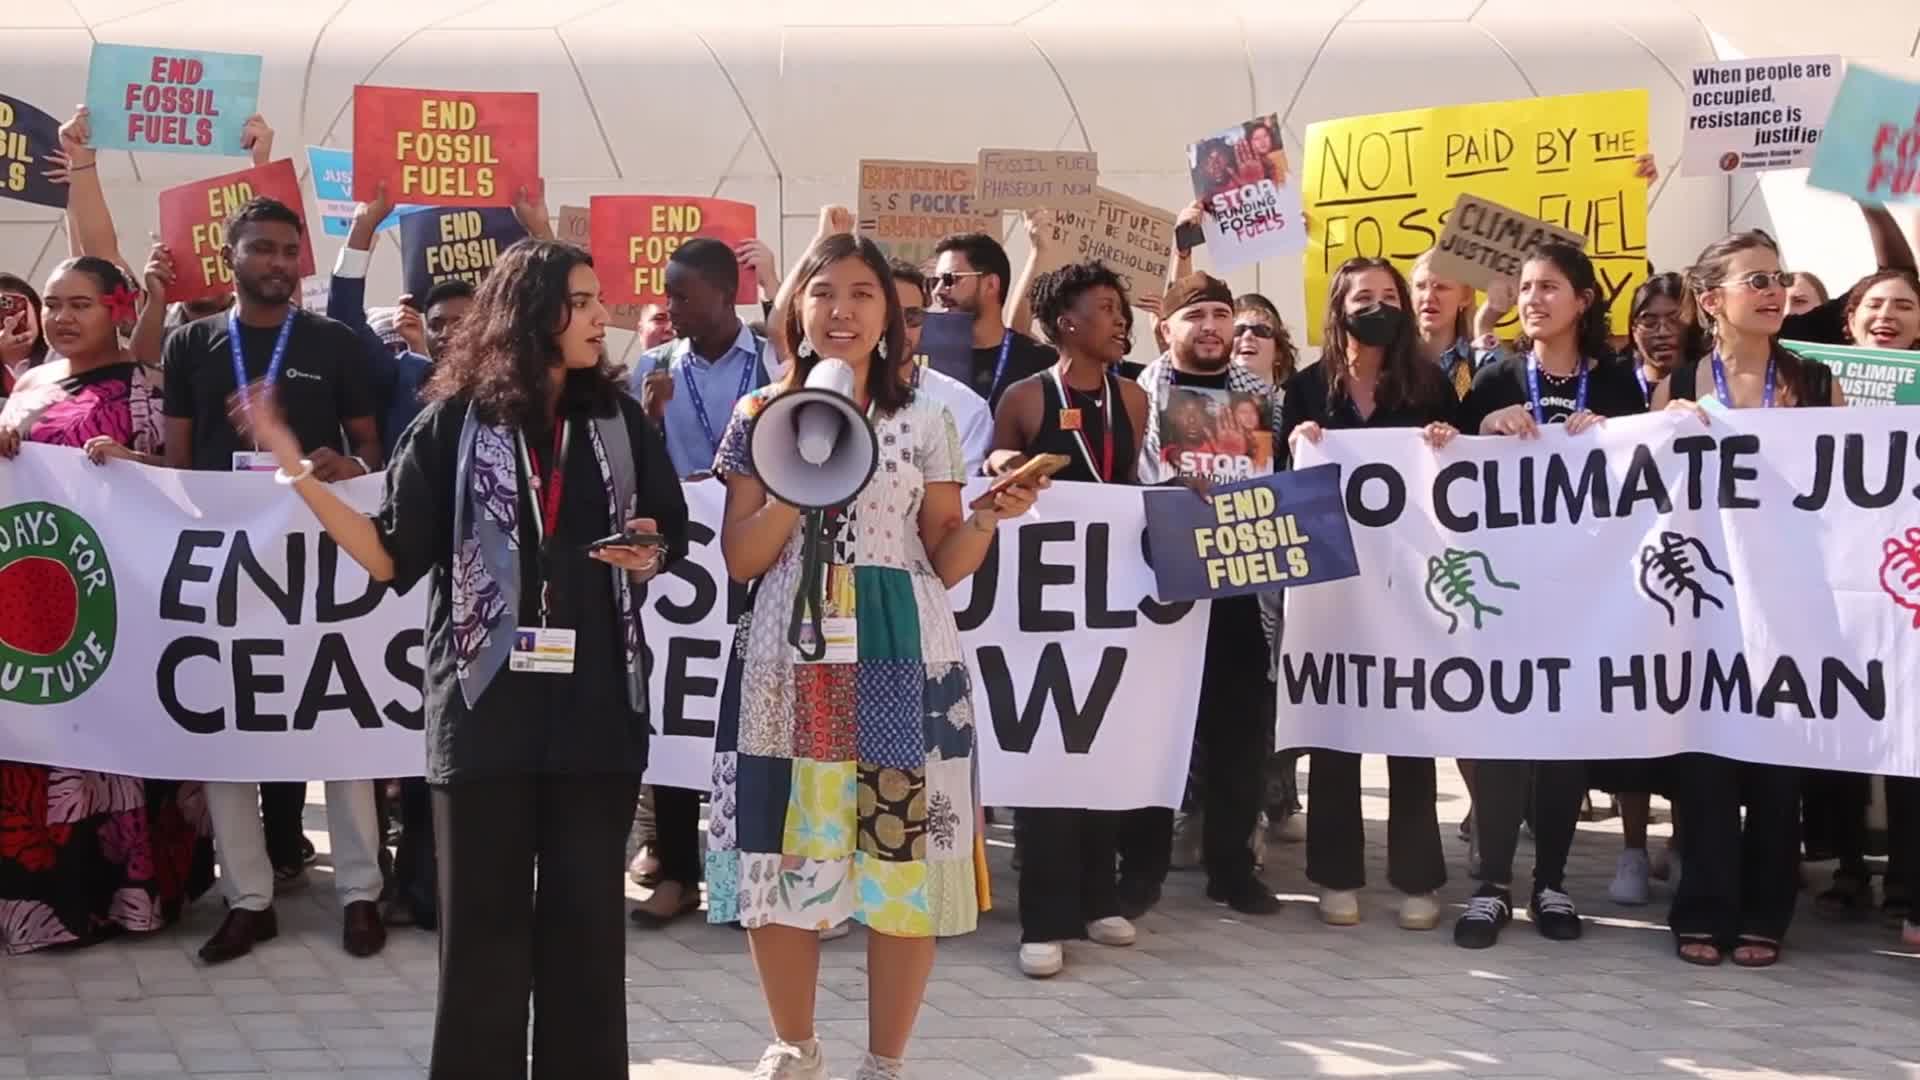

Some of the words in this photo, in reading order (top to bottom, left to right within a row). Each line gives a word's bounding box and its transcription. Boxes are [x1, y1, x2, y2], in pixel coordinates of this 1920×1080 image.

[151, 56, 203, 84] END
[1693, 67, 1741, 86] When
[1745, 62, 1802, 83] people
[1806, 63, 1831, 78] are
[124, 83, 219, 116] FOSSIL
[421, 100, 476, 130] END
[128, 114, 213, 146] FUELS
[1690, 108, 1782, 130] resistance
[1787, 106, 1802, 122] is
[396, 132, 499, 164] FOSSIL
[1754, 126, 1822, 147] justifie
[1056, 155, 1099, 173] FUEL
[1319, 127, 1422, 198] NOT
[1536, 128, 1577, 164] BY
[1589, 130, 1635, 153] THE
[403, 165, 494, 197] FUELS
[1212, 179, 1274, 211] STOP
[651, 205, 702, 234] END
[1098, 200, 1161, 239] FUTURE
[1217, 195, 1277, 221] FUNDING
[1220, 207, 1283, 234] FOSSIL
[440, 210, 482, 242] END
[1105, 224, 1120, 239] BE
[629, 236, 691, 265] FOS
[1441, 234, 1521, 275] JUSTICE
[1846, 362, 1916, 384] CLIMATE
[1180, 451, 1251, 473] STOP
[1433, 434, 1760, 532] CLIMATE
[1793, 430, 1920, 511] JU
[1214, 487, 1276, 524] END
[1194, 514, 1310, 558] FOSSIL
[69, 533, 107, 597] FOR
[1206, 546, 1310, 590] FUELS
[1283, 652, 1571, 714] WITHOUT
[1599, 648, 1886, 721] HUMAN
